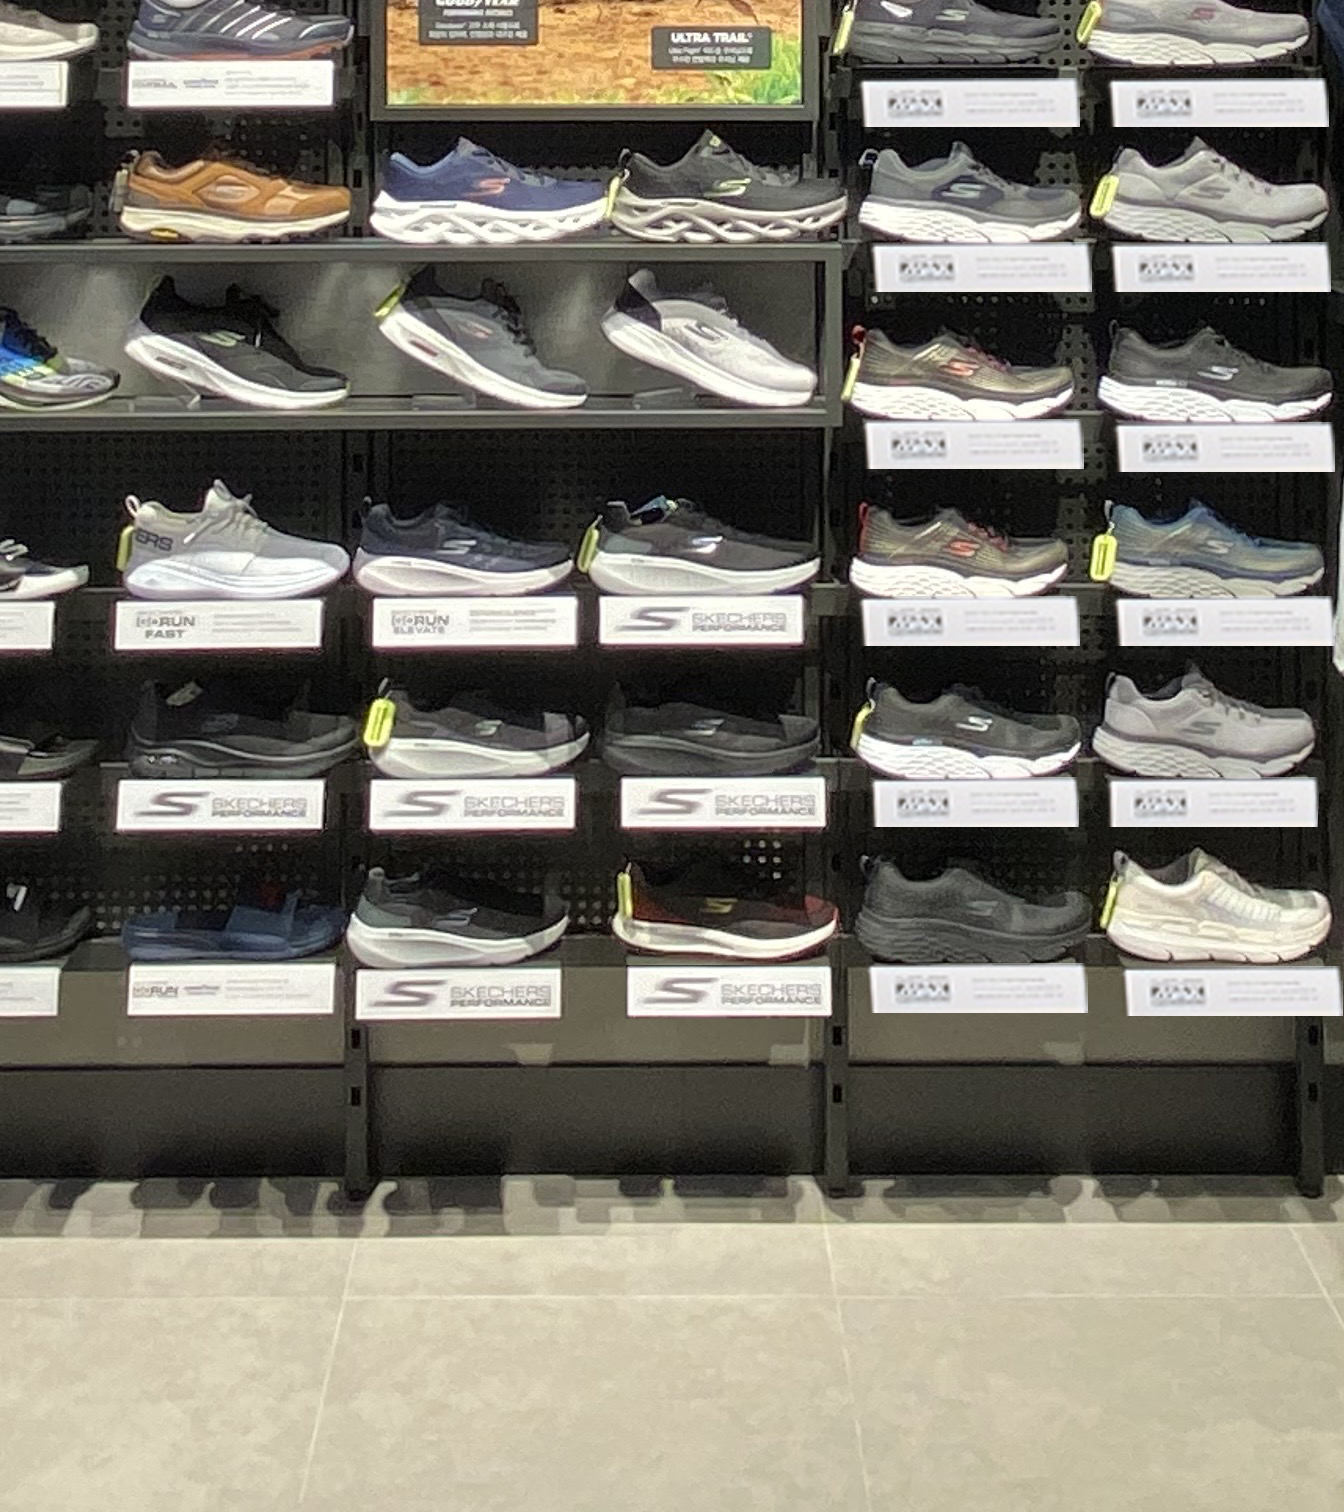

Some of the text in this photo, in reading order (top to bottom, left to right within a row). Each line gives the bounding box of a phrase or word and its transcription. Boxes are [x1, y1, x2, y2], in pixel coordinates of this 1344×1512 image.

[670, 31, 711, 44] ULTRA
[692, 612, 788, 624] SKECHERS
[145, 629, 186, 639] FAST
[212, 797, 308, 810] SKECHERS
[464, 795, 565, 808] SKECHERS
[714, 794, 816, 807] SKECHERS
[451, 983, 553, 996] SKECHERS
[722, 983, 822, 996] SKECHERS
